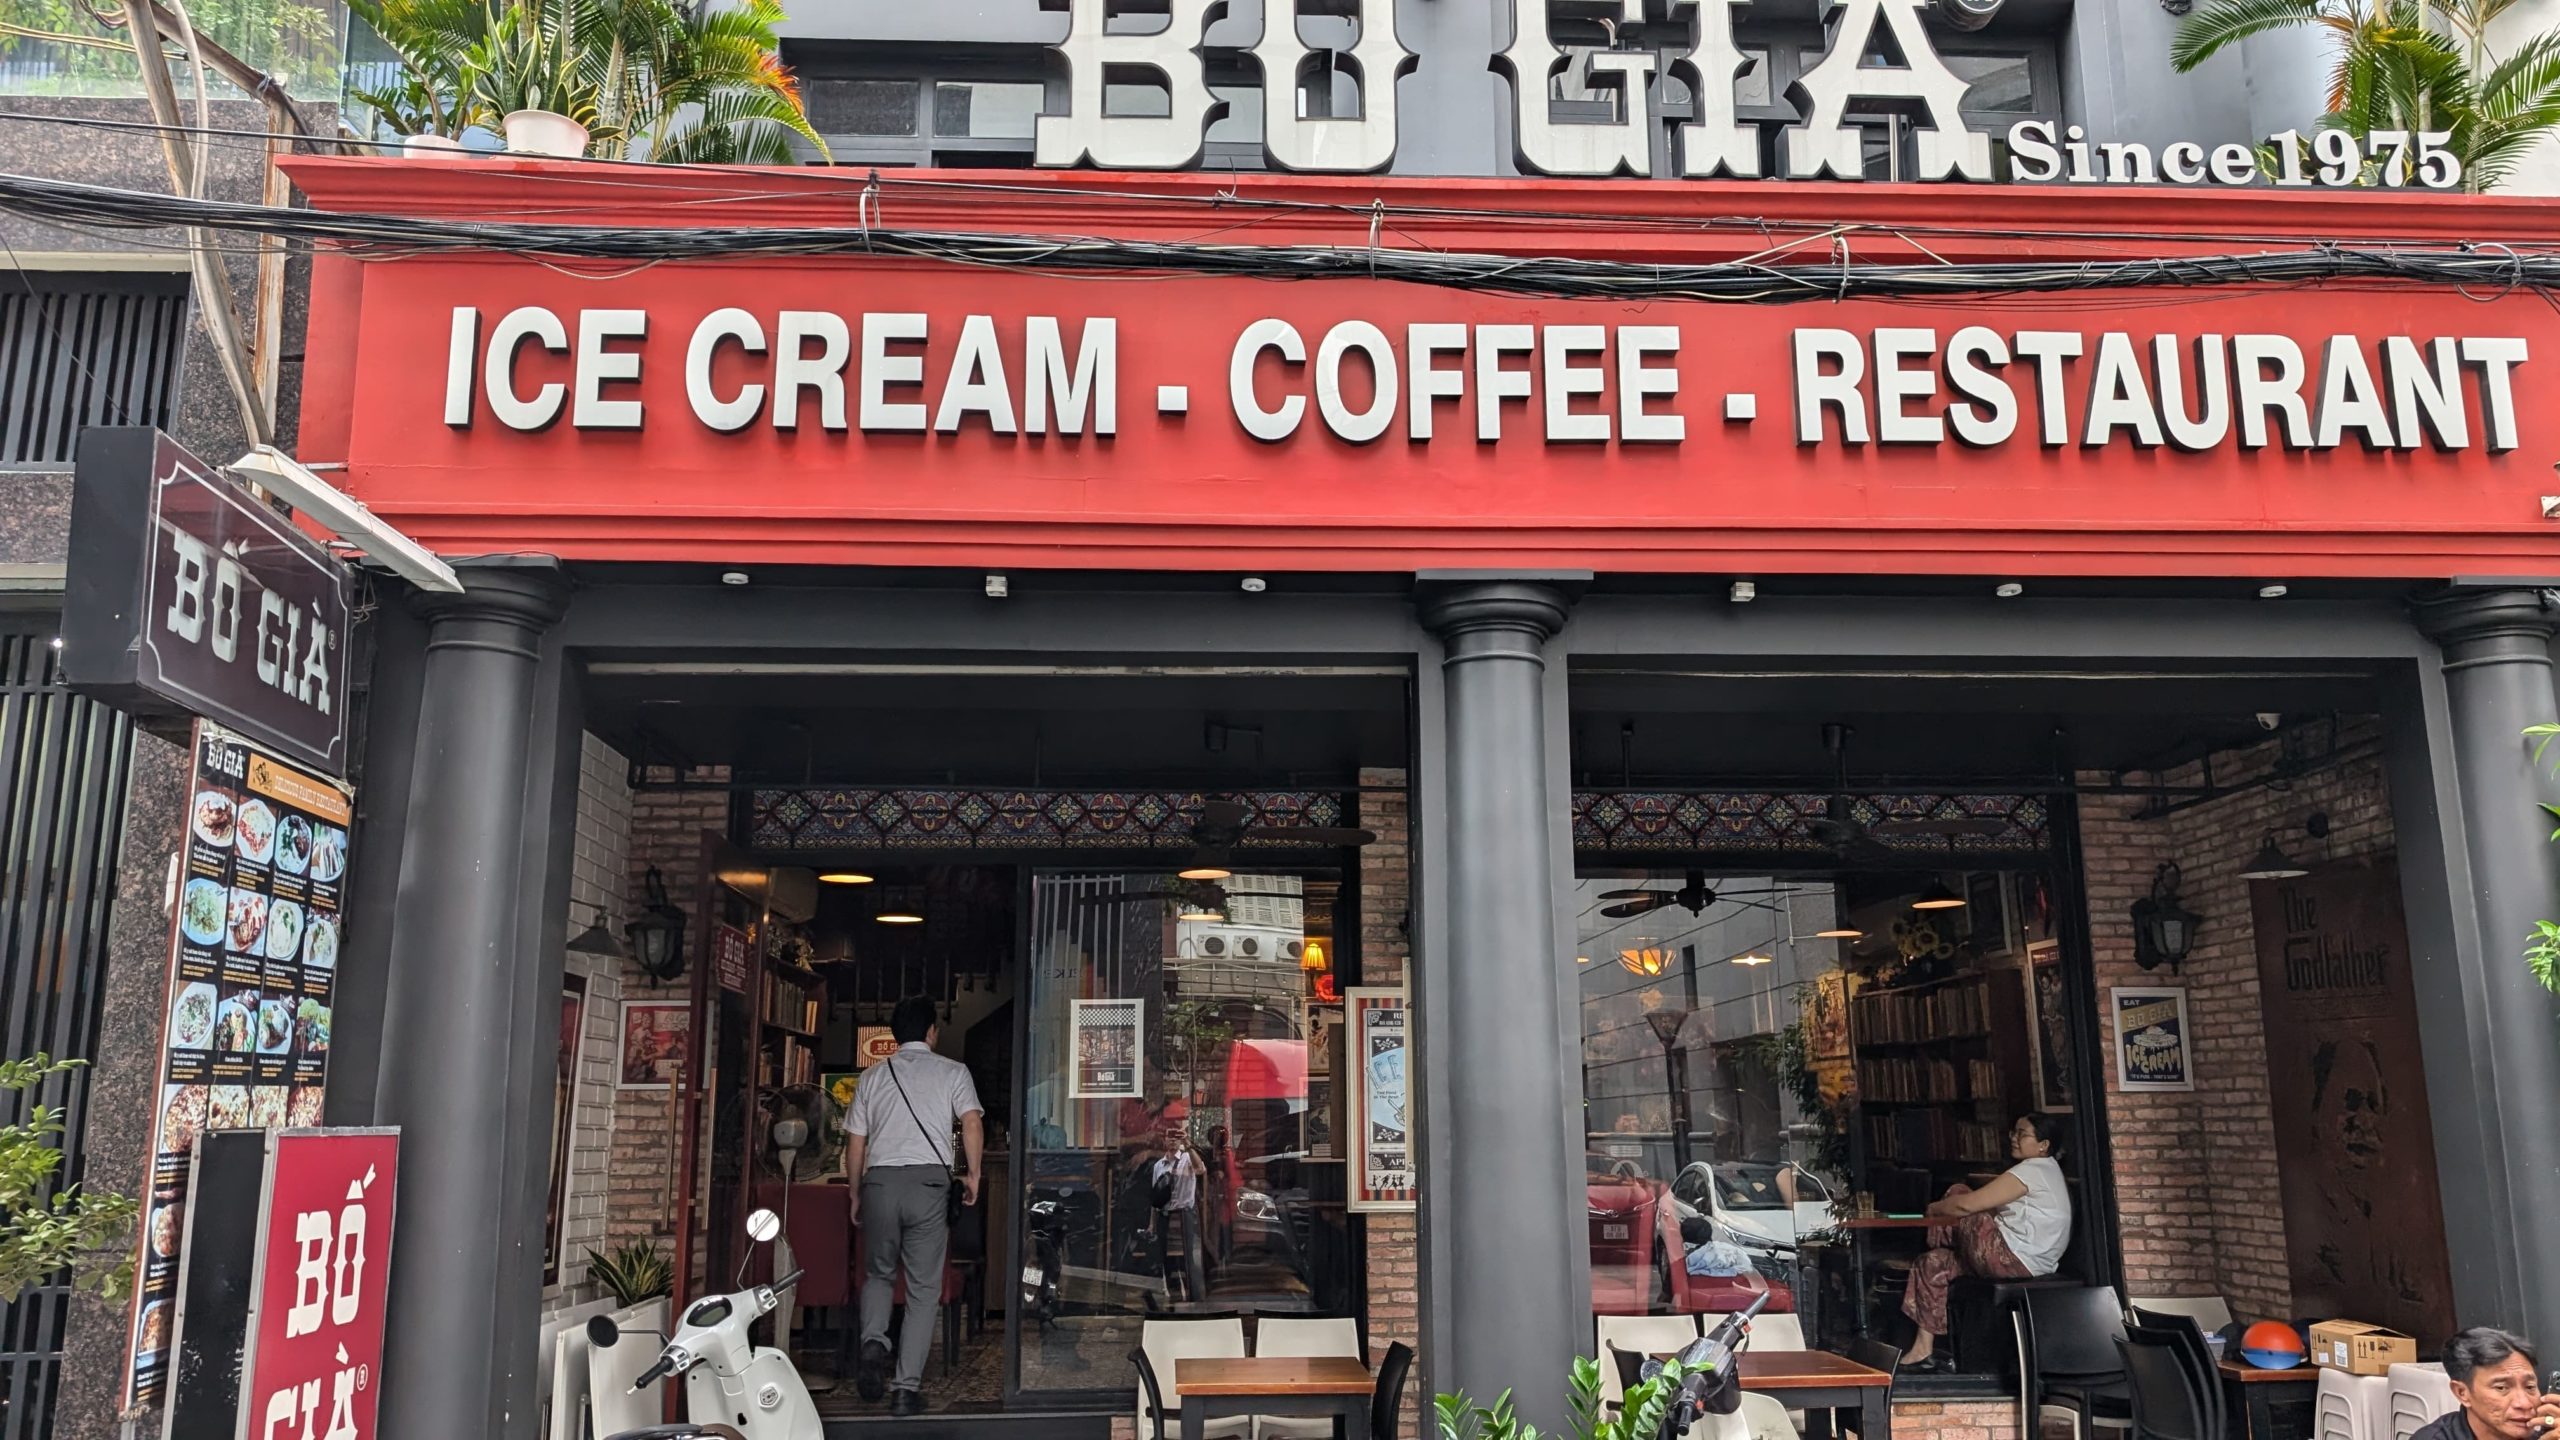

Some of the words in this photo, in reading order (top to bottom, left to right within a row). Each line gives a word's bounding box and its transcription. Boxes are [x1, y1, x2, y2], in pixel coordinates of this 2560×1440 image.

[2008, 120, 2256, 185] Since
[2269, 127, 2462, 188] 1975
[444, 306, 646, 430] ICE
[686, 307, 1117, 433] CREAM
[1230, 318, 1686, 440] COFFEE
[1794, 327, 2529, 449] RESTAURANT
[166, 527, 250, 664] BỐ
[2125, 1044, 2145, 1070] ICE
[2140, 1046, 2181, 1073] CREAM
[286, 1163, 377, 1339] BỐ
